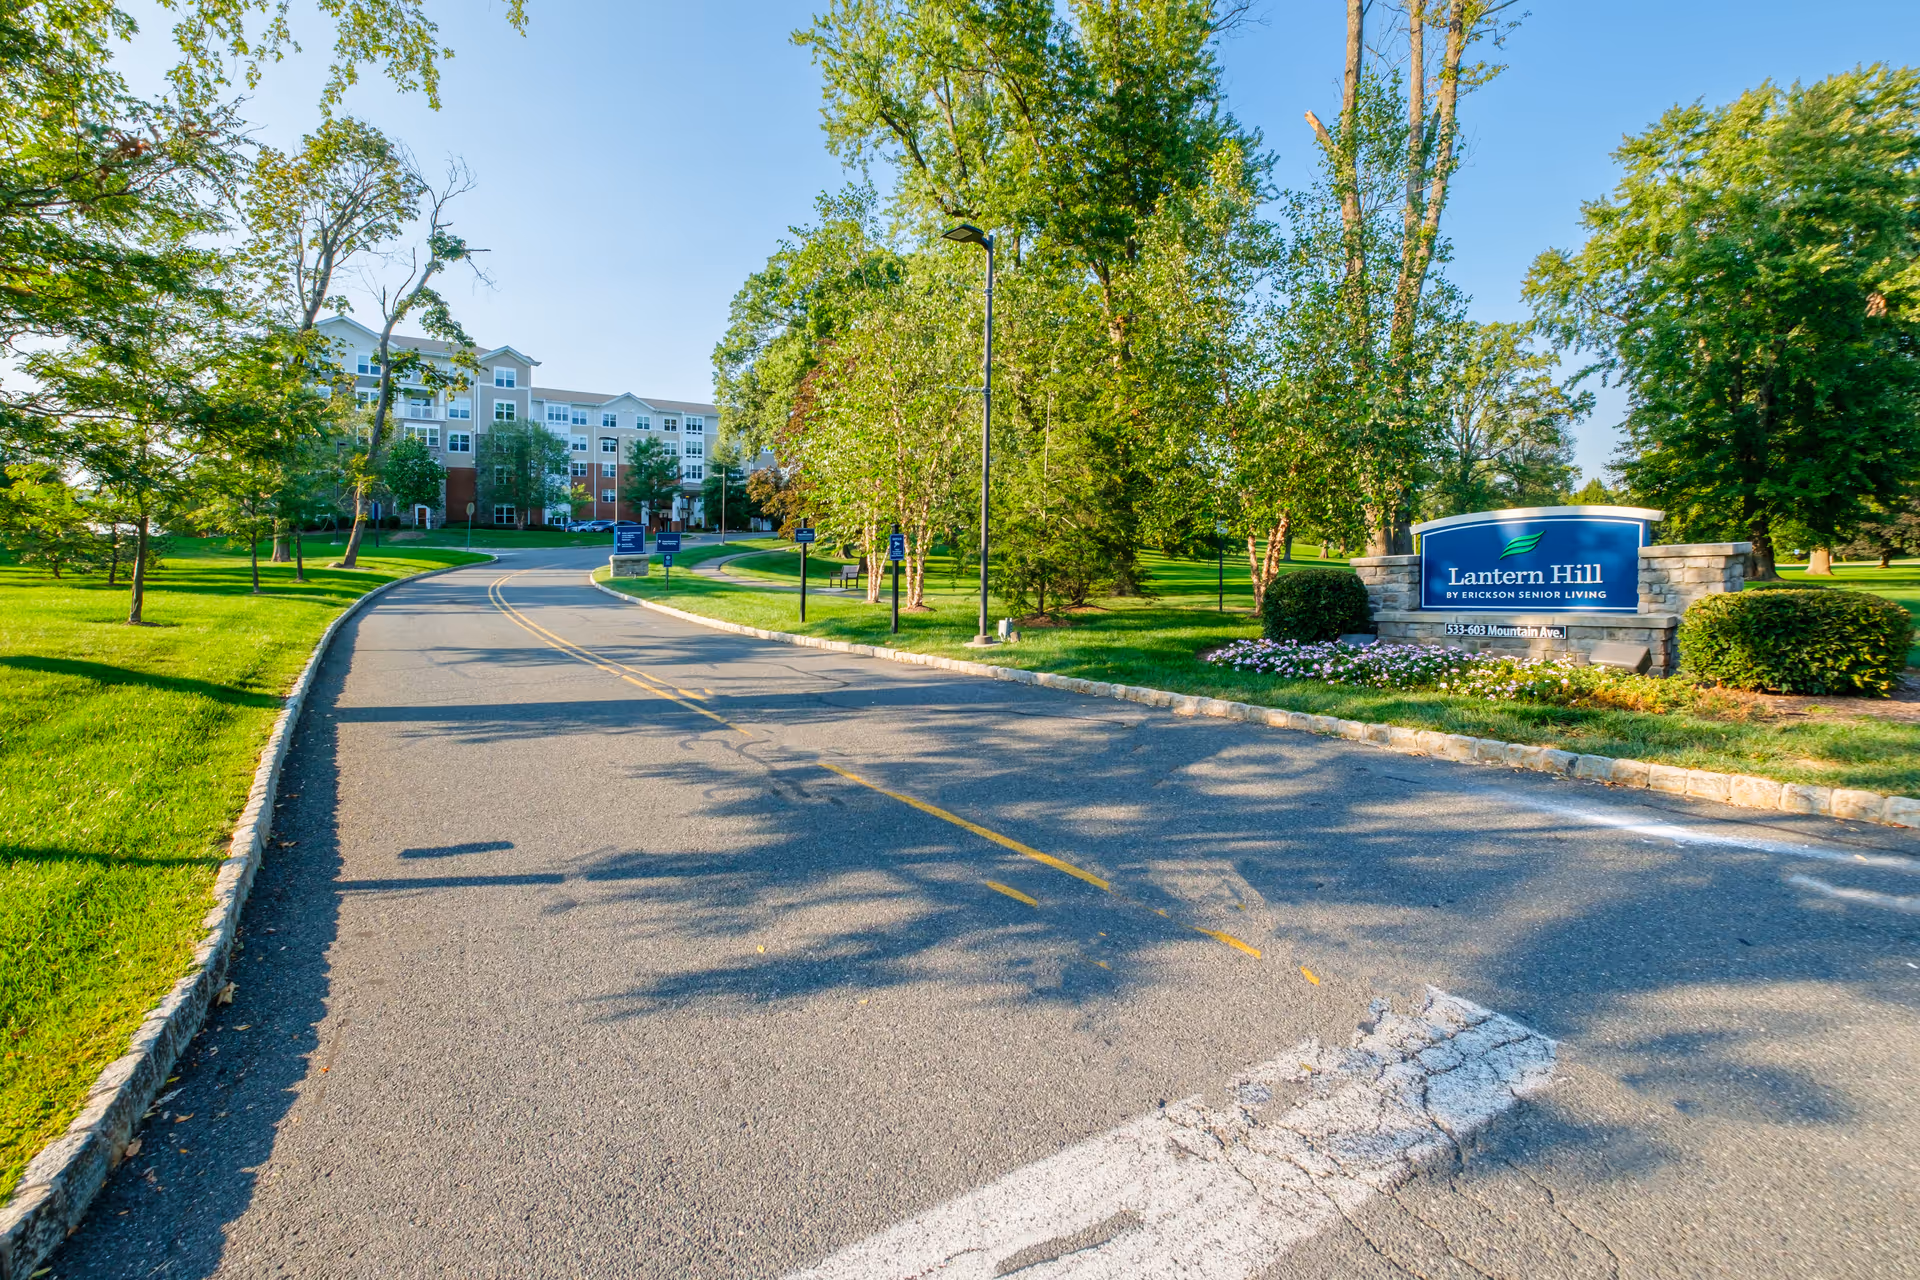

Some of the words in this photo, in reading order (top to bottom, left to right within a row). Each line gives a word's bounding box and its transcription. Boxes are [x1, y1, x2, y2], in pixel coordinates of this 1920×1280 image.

[1448, 567, 1545, 586] Lantern
[1550, 563, 1604, 584] Hill
[1446, 591, 1459, 599] BY
[1462, 591, 1515, 599] ERICKSON
[1518, 591, 1561, 599] SENIOR
[1565, 591, 1607, 599] LIVING
[1447, 624, 1486, 635] 533-603
[1487, 626, 1541, 638] Mountain
[1540, 627, 1564, 639] Ave.
